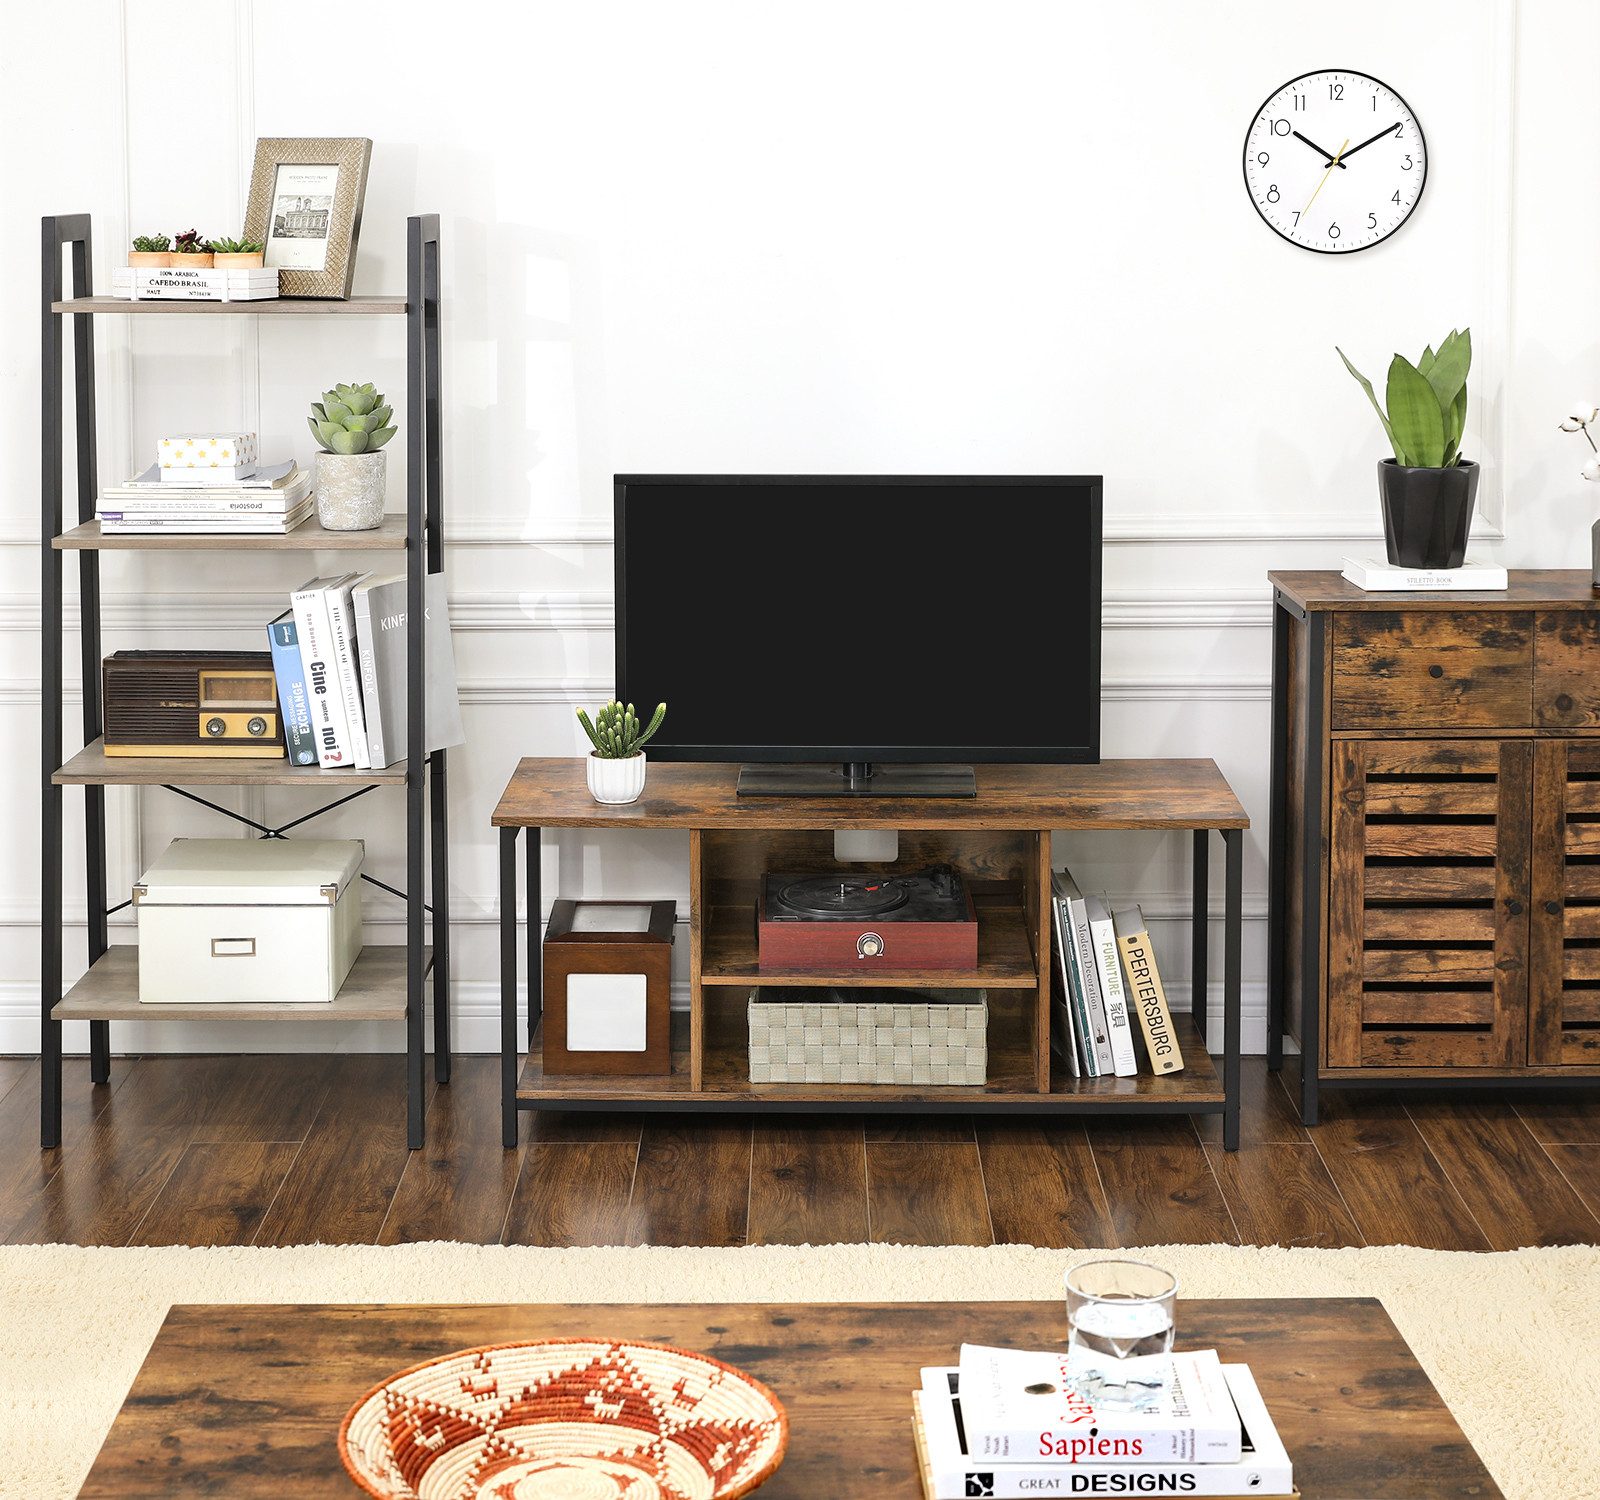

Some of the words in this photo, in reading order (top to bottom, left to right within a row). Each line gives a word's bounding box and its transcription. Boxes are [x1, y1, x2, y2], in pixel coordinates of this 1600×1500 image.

[1328, 84, 1344, 100] 12
[1294, 94, 1306, 111] 11
[1372, 96, 1376, 112] 1
[1270, 118, 1292, 136] 10
[1394, 122, 1404, 138] 2
[1258, 152, 1270, 168] 9
[1400, 154, 1413, 170] 3
[1266, 184, 1280, 204] 8
[1391, 189, 1402, 206] 4
[1292, 212, 1300, 227] 7
[1368, 212, 1377, 230] 5
[1328, 222, 1340, 238] 6
[230, 502, 263, 511] prostoria
[380, 608, 430, 632] KINFK
[332, 606, 340, 622] THE
[336, 624, 346, 651] STORY
[341, 653, 349, 665] OF
[362, 649, 376, 695] KINFOLK
[310, 661, 326, 694] Cine
[320, 699, 330, 722] suntem
[286, 694, 298, 724] MESSAGING
[292, 681, 310, 734] EXCHANGE
[291, 723, 300, 746] SECURE
[1078, 922, 1089, 959] Modern
[1084, 961, 1098, 1010] Decoration
[1102, 941, 1120, 997] FURNITURE
[1127, 948, 1172, 1056] PERTERSBURG
[1109, 1002, 1126, 1028] 家具
[1039, 1428, 1144, 1464] Sapiens
[1019, 1478, 1062, 1490] GREAT
[1071, 1474, 1196, 1492] DESIGNS
